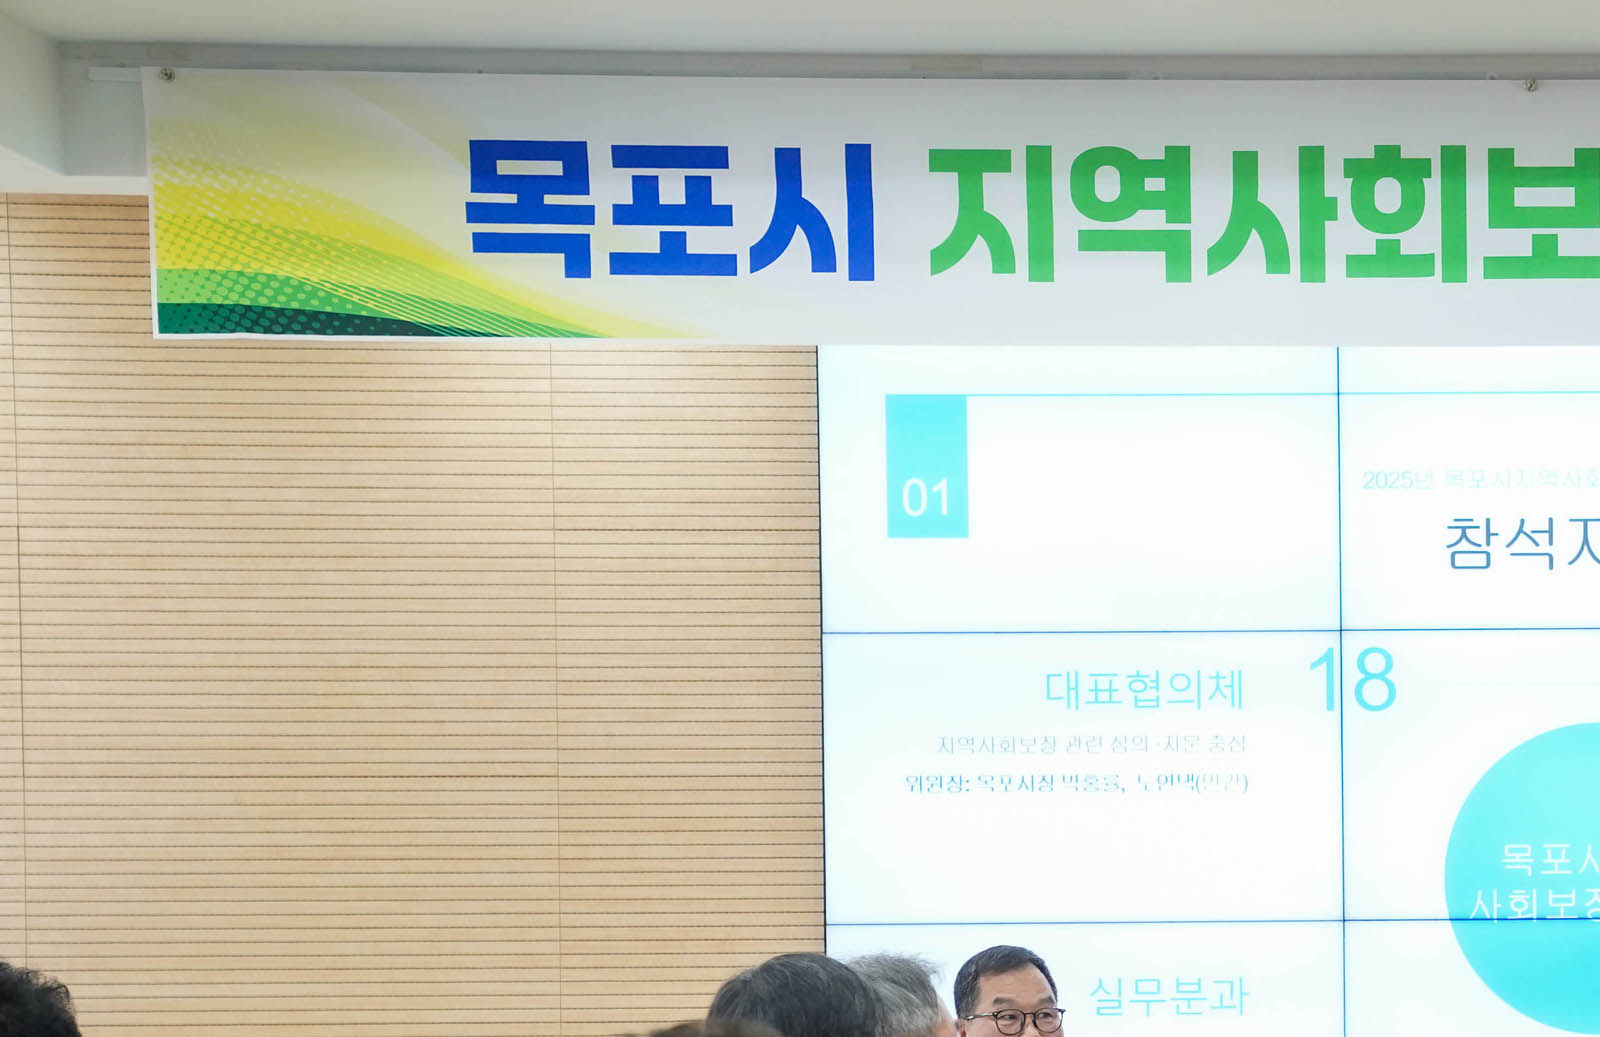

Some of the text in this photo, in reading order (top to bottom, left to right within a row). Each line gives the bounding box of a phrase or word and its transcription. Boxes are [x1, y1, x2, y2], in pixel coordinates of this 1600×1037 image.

[466, 139, 875, 281] 목포시
[902, 477, 949, 517] 01
[1361, 469, 1435, 490] 2025년
[1045, 669, 1244, 711] 대표협의체
[1310, 646, 1396, 712] 18
[1089, 976, 1250, 1017] 실무분과
